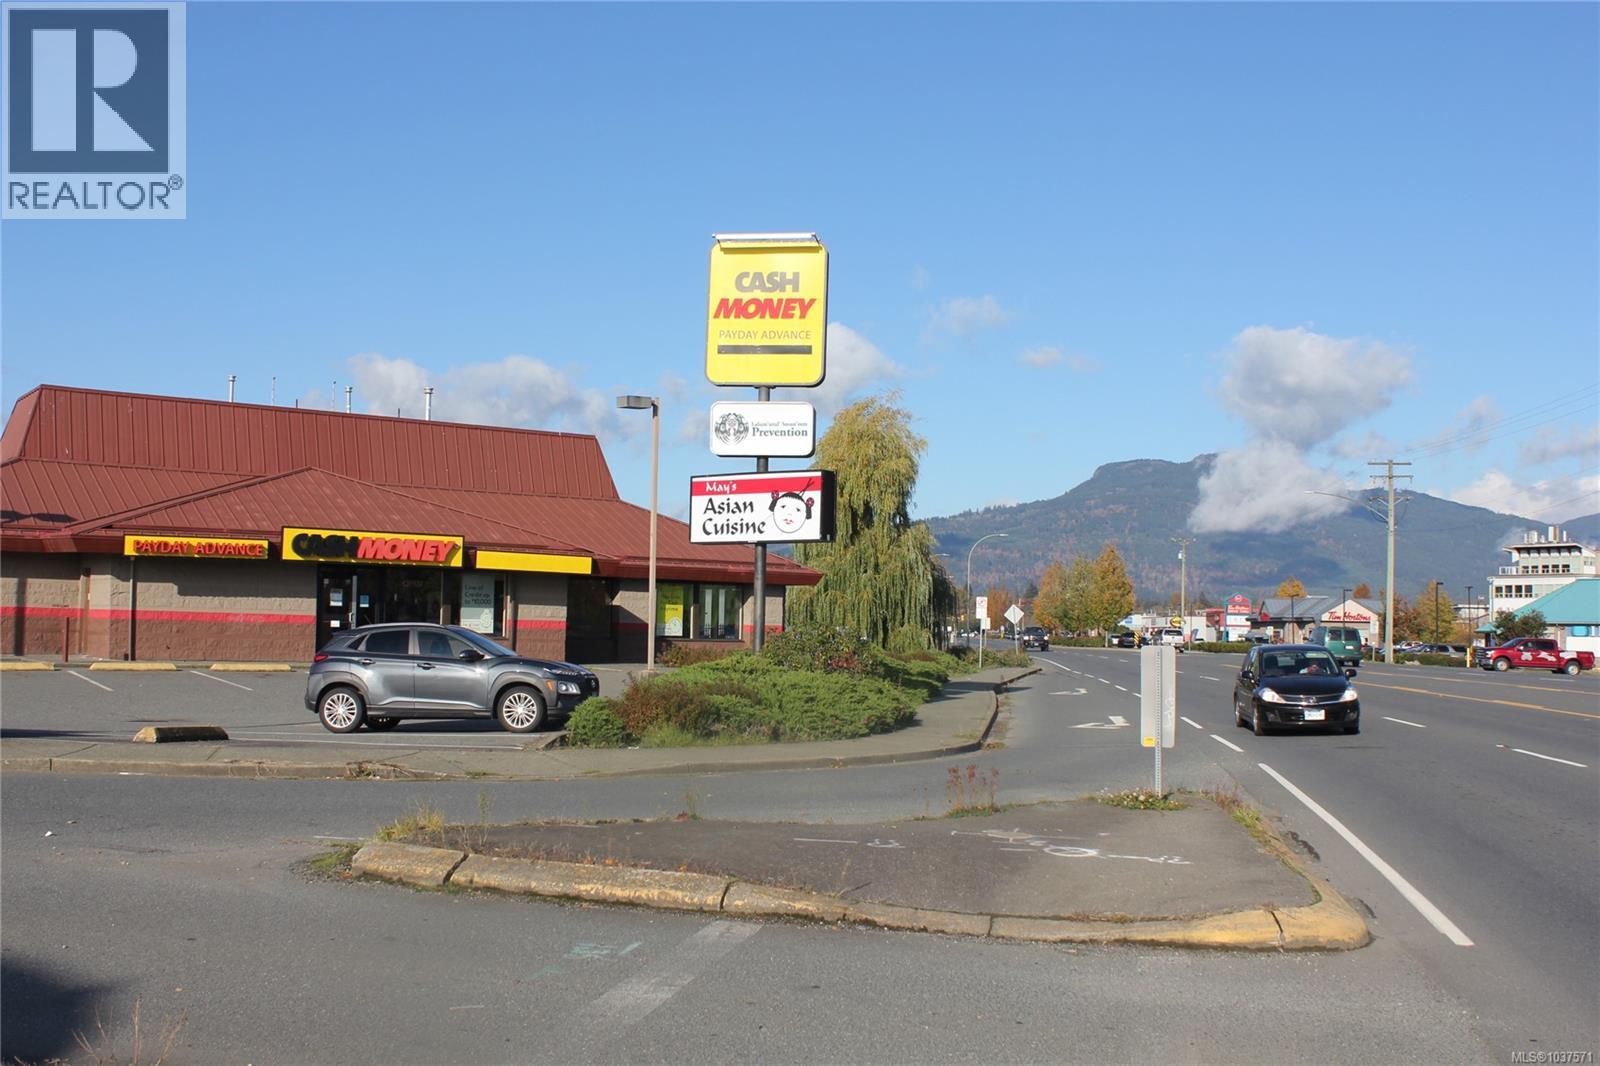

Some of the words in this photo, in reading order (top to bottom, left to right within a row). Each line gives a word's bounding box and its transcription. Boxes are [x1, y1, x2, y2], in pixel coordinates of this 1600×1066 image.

[735, 271, 800, 293] CASH
[713, 298, 817, 319] MONEY
[719, 330, 759, 340] PAYDAY
[761, 330, 812, 340] ADVANCE
[752, 427, 808, 437] Prevention
[705, 482, 737, 493] May's
[703, 497, 754, 515] Asian
[702, 518, 766, 536] Cuisine
[132, 539, 191, 554] PAYDAY
[194, 542, 265, 556] ADVANCE
[292, 533, 361, 559] CASH
[357, 537, 456, 562] MONEY
